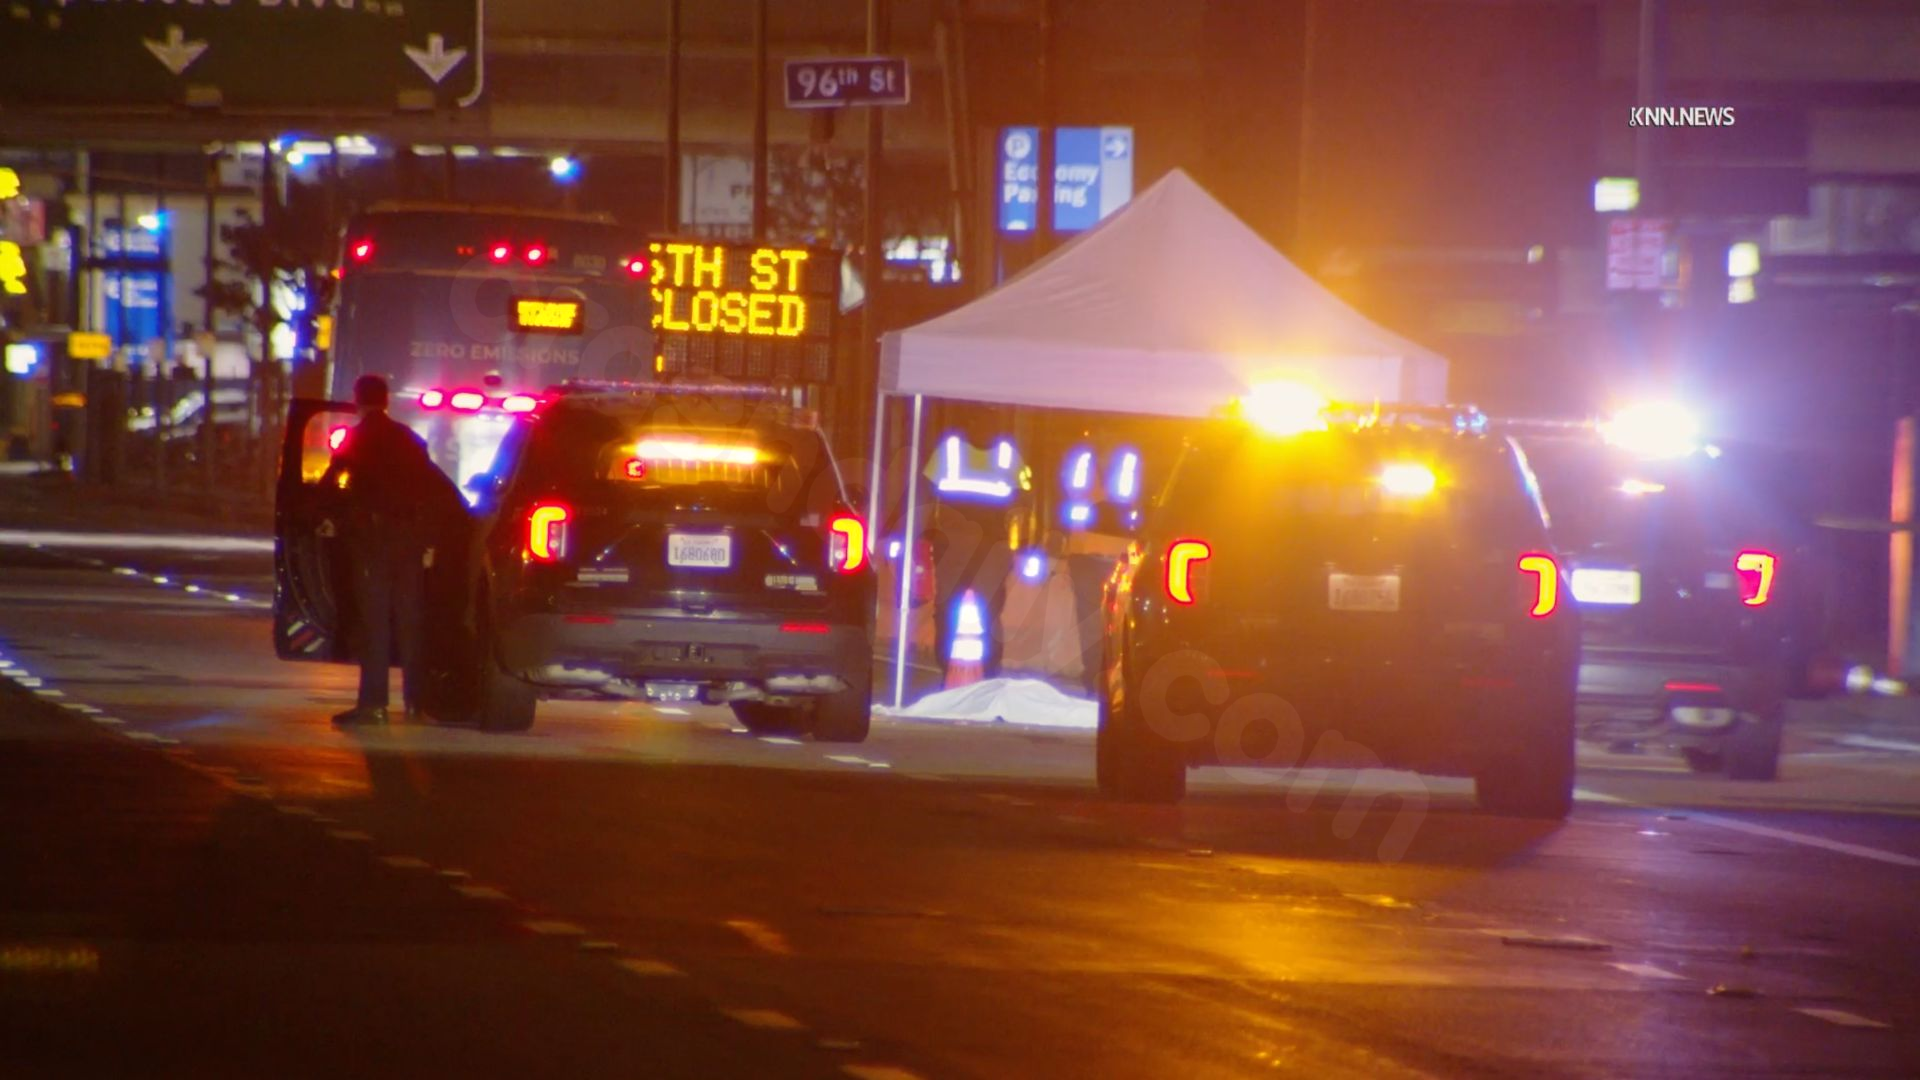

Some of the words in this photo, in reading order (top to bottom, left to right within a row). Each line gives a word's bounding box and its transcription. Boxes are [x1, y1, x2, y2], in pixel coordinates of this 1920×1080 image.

[798, 66, 858, 98] 96th
[869, 66, 896, 93] St
[750, 249, 809, 292] ST
[410, 341, 466, 361] ZERO
